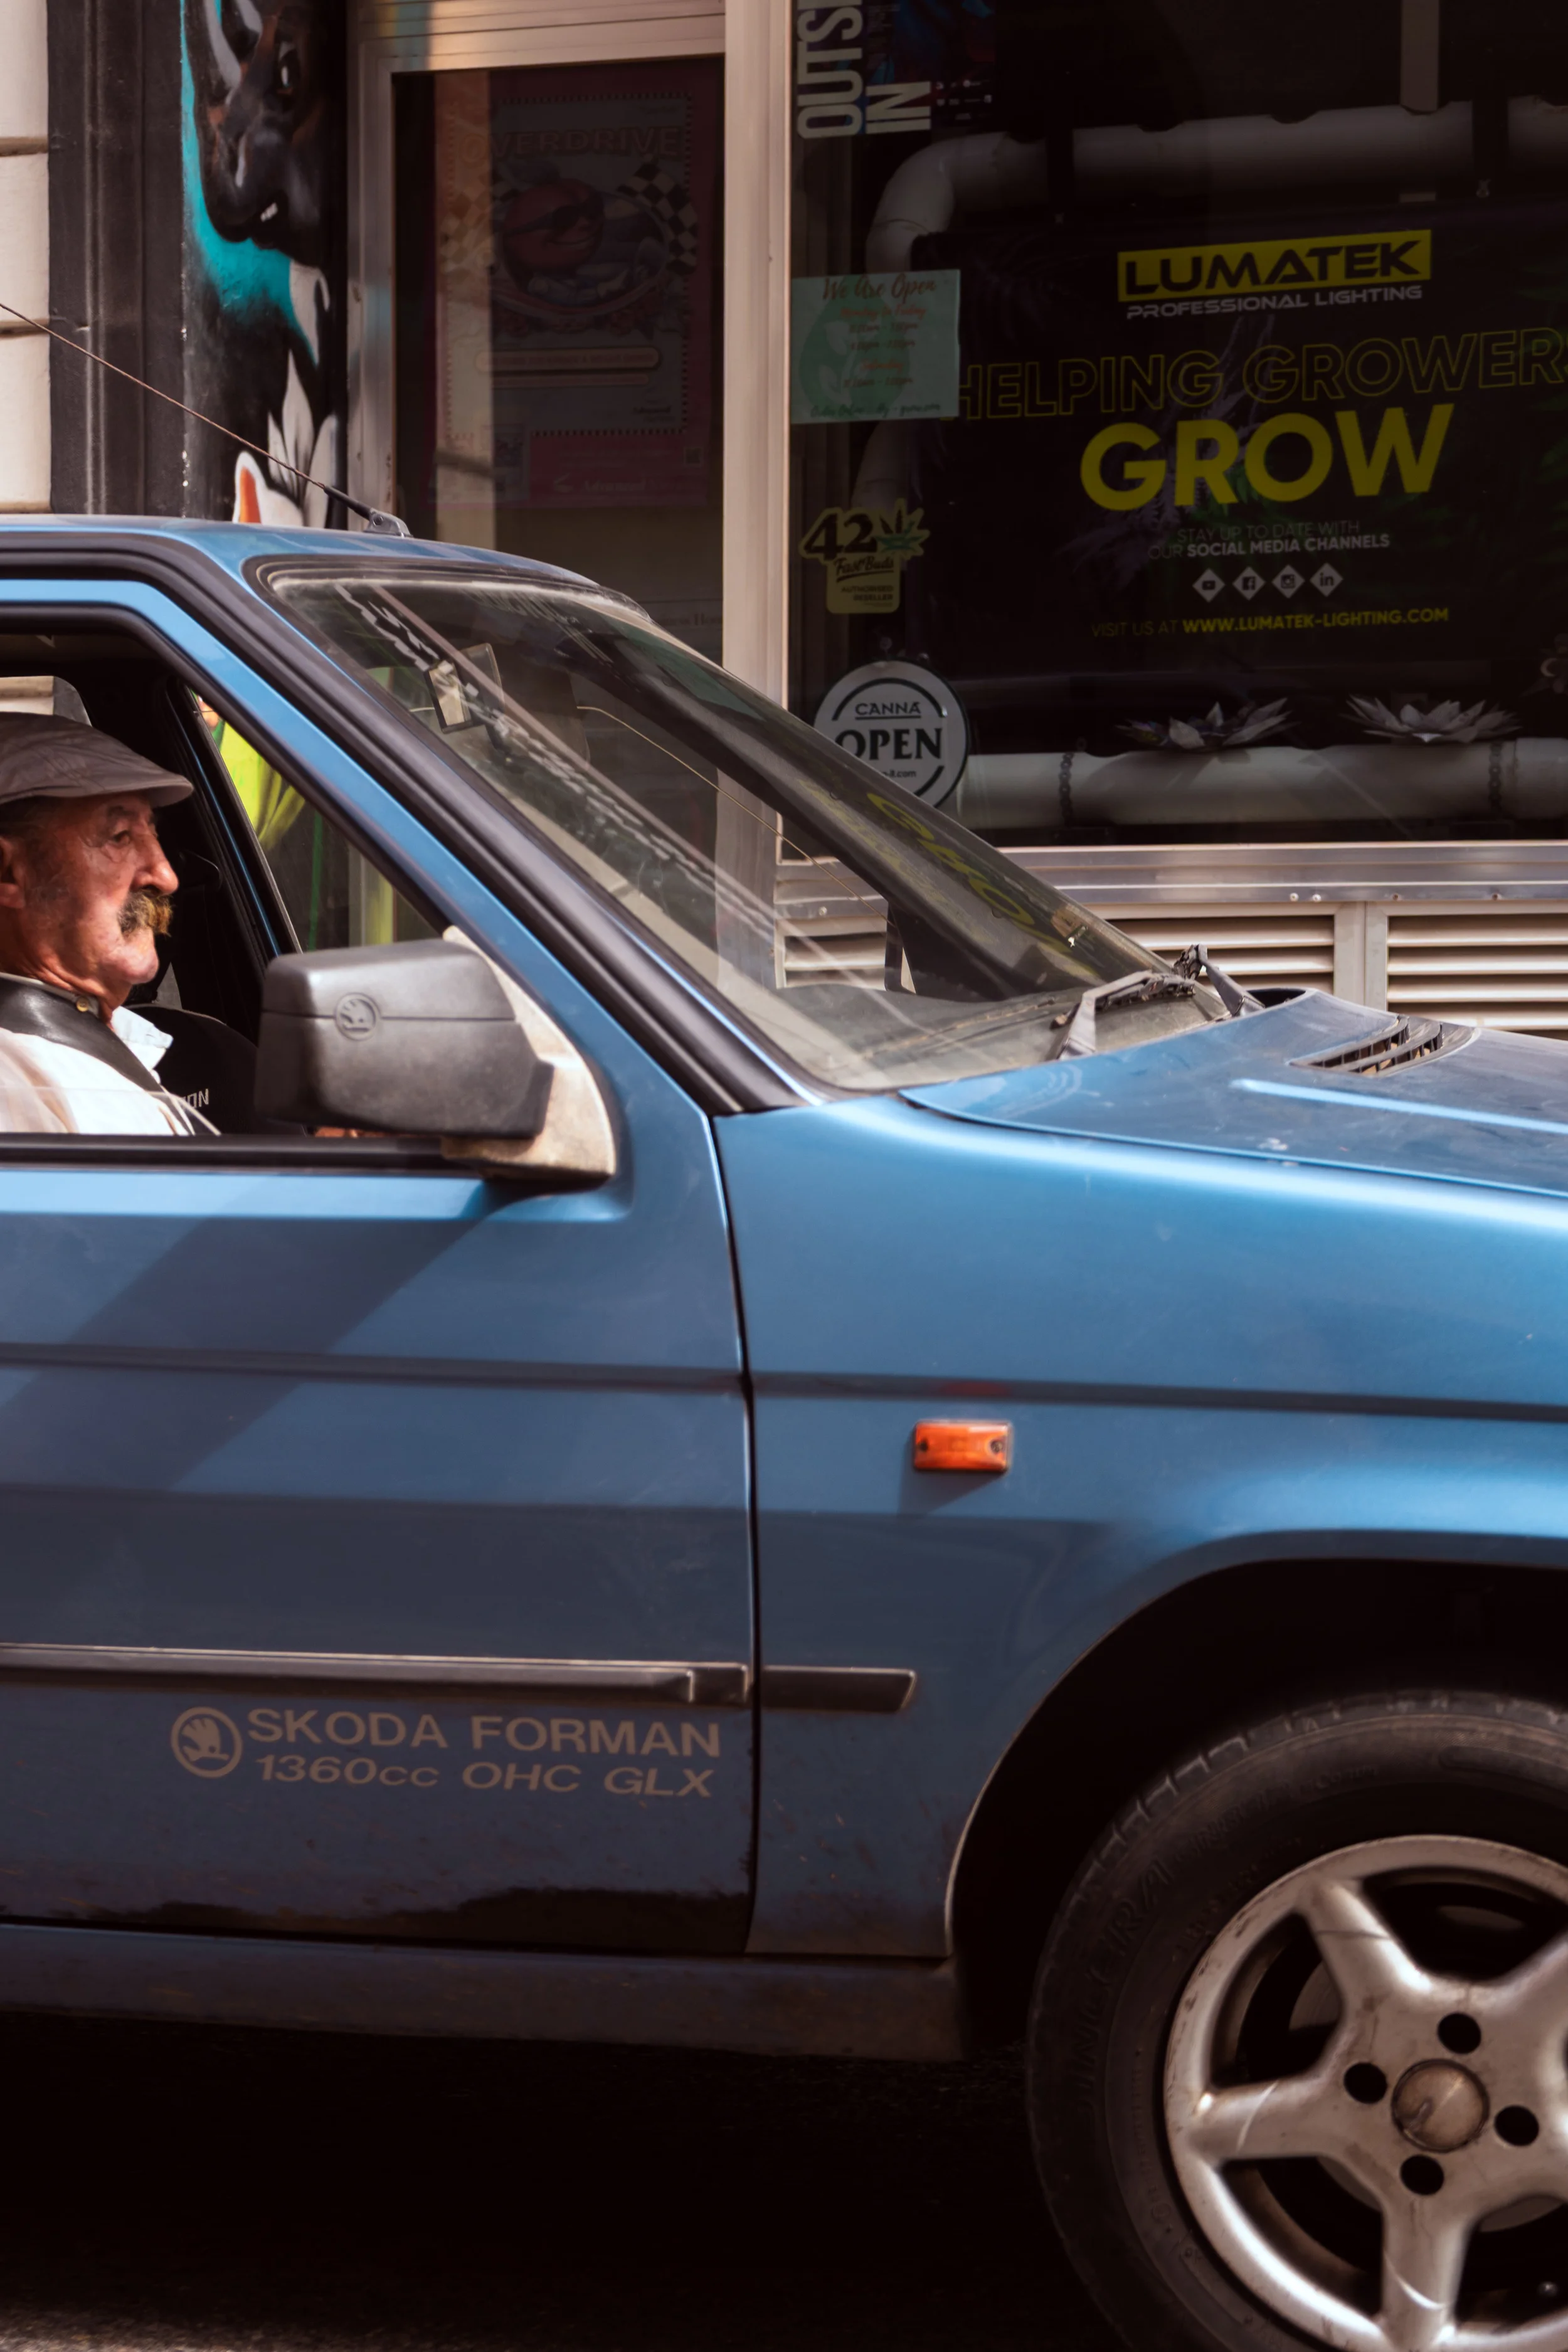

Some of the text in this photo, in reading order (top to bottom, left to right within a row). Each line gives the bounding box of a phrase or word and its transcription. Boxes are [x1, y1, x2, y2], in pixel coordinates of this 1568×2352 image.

[865, 80, 931, 134] IN
[1126, 240, 1422, 295] LUMATEK
[822, 272, 936, 304] We Are Open
[1126, 285, 1423, 319] PROFESSIONAL LIGHTING
[960, 326, 1568, 420] HELPING GROWER
[1080, 403, 1454, 511] GROW
[1148, 533, 1391, 560] OUR SOCIAL MEDIA CHANNELS
[1177, 520, 1360, 543] STAY UP TO DATE WITH
[1091, 608, 1449, 637] VISIT US AT WWW.LUMATEK-LIGHTING.COM
[855, 701, 921, 716] CANNA
[835, 728, 943, 760] OPEN
[183, 1088, 209, 1108] ON
[247, 1708, 721, 1757] SKODA FORMAN
[256, 1755, 714, 1798] 1360cc OHC GLX
